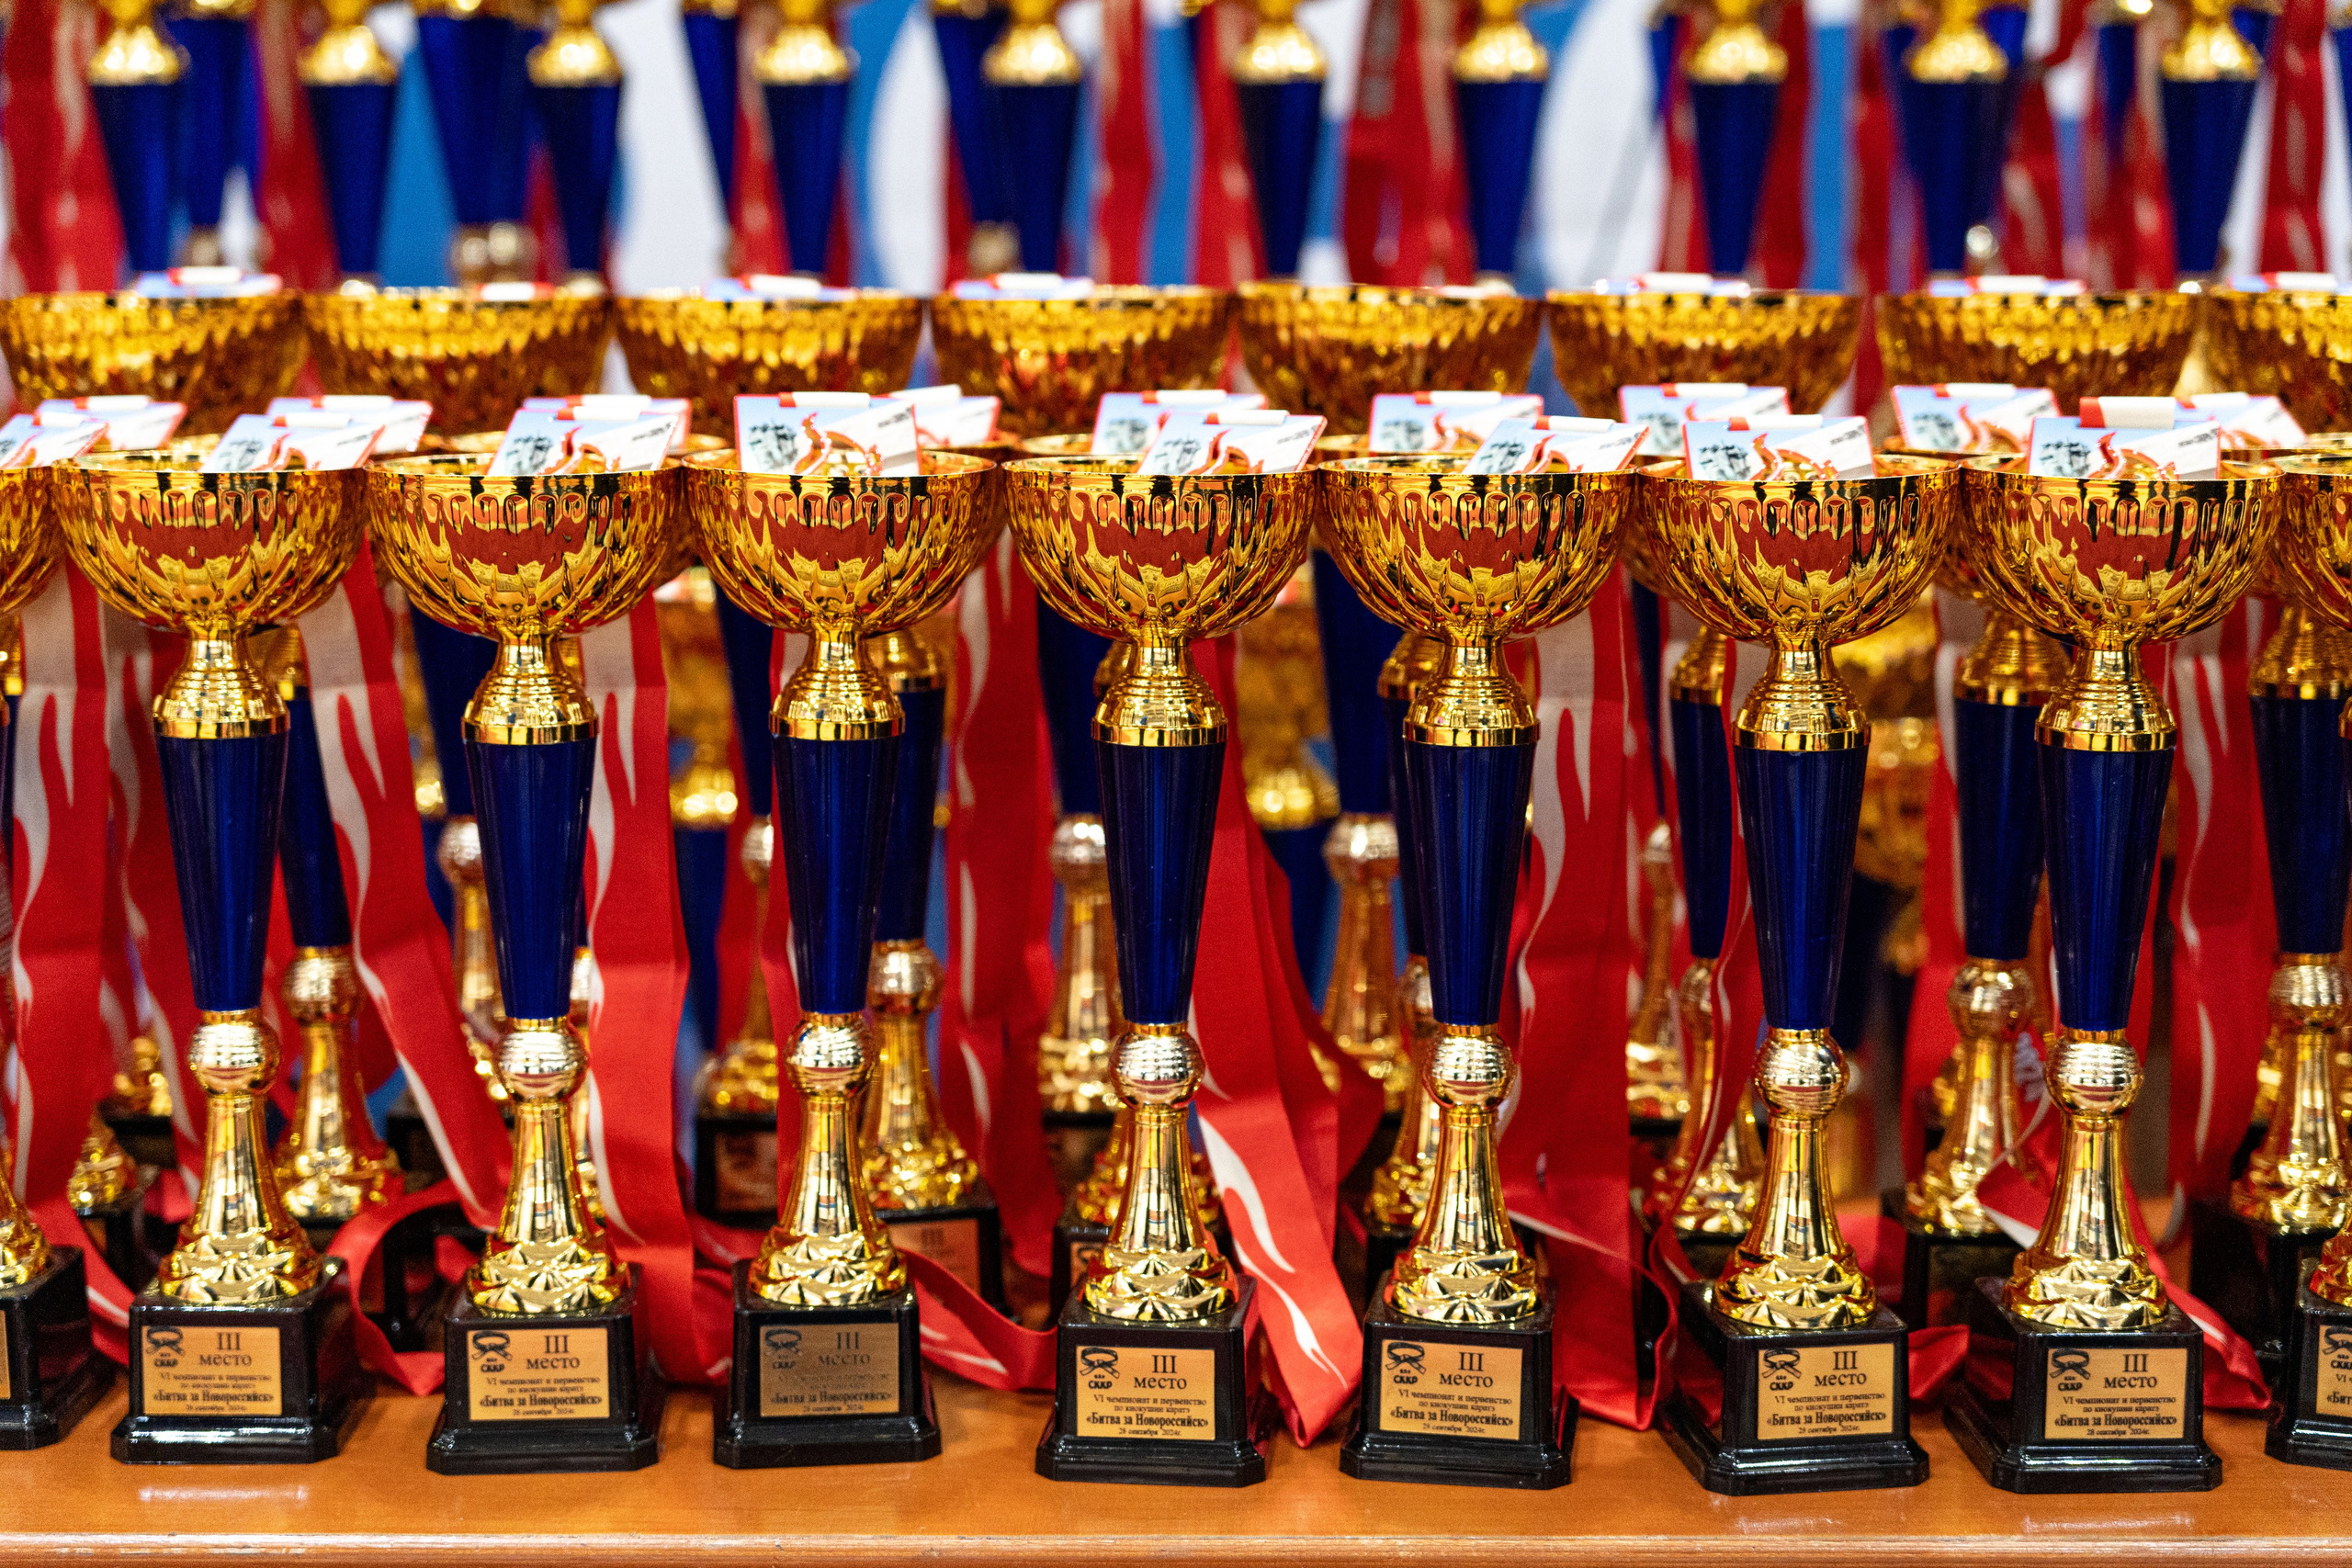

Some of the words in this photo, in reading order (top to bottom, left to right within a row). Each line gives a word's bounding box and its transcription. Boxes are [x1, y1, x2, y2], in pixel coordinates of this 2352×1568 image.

[217, 1332, 241, 1350] III
[544, 1335, 569, 1354] III
[837, 1332, 859, 1350] III
[199, 1355, 252, 1366] место
[526, 1358, 581, 1370] место
[1152, 1355, 1177, 1373] III
[1458, 1352, 1484, 1371] III
[1833, 1351, 1858, 1370] III
[2123, 1354, 2148, 1372] III
[1089, 1381, 1113, 1390] СККР
[1134, 1377, 1187, 1390] место
[1394, 1375, 1418, 1384] СККР
[1440, 1373, 1493, 1388] место
[1815, 1373, 1867, 1386] место
[2104, 1376, 2157, 1389] место
[1770, 1382, 1793, 1391] СККР
[2058, 1382, 2082, 1391] СККР
[481, 1395, 514, 1407] «Битва
[517, 1397, 526, 1405] за
[529, 1394, 602, 1408] Новороссийск»
[1160, 1398, 1207, 1406] первенство
[1398, 1389, 1408, 1397] VI
[1411, 1392, 1455, 1401] чемпионат
[1465, 1396, 1512, 1404] первенство
[1840, 1393, 1885, 1403] первенство
[2130, 1397, 2176, 1405] первенство
[2327, 1391, 2352, 1404] «Бит
[1087, 1412, 1121, 1425] «Битва
[1124, 1416, 1133, 1425] за
[1136, 1414, 1208, 1429] Новороссийск»
[1390, 1406, 1425, 1419] «Битва
[1441, 1410, 1513, 1427] Новороссийск»
[1767, 1414, 1801, 1426] «Битва
[1804, 1416, 1813, 1424] за
[1815, 1410, 1886, 1426] Новороссийск»
[2054, 1415, 2089, 1427] «Битва
[2093, 1417, 2101, 1426] за
[2105, 1415, 2177, 1428] Новороссийск»
